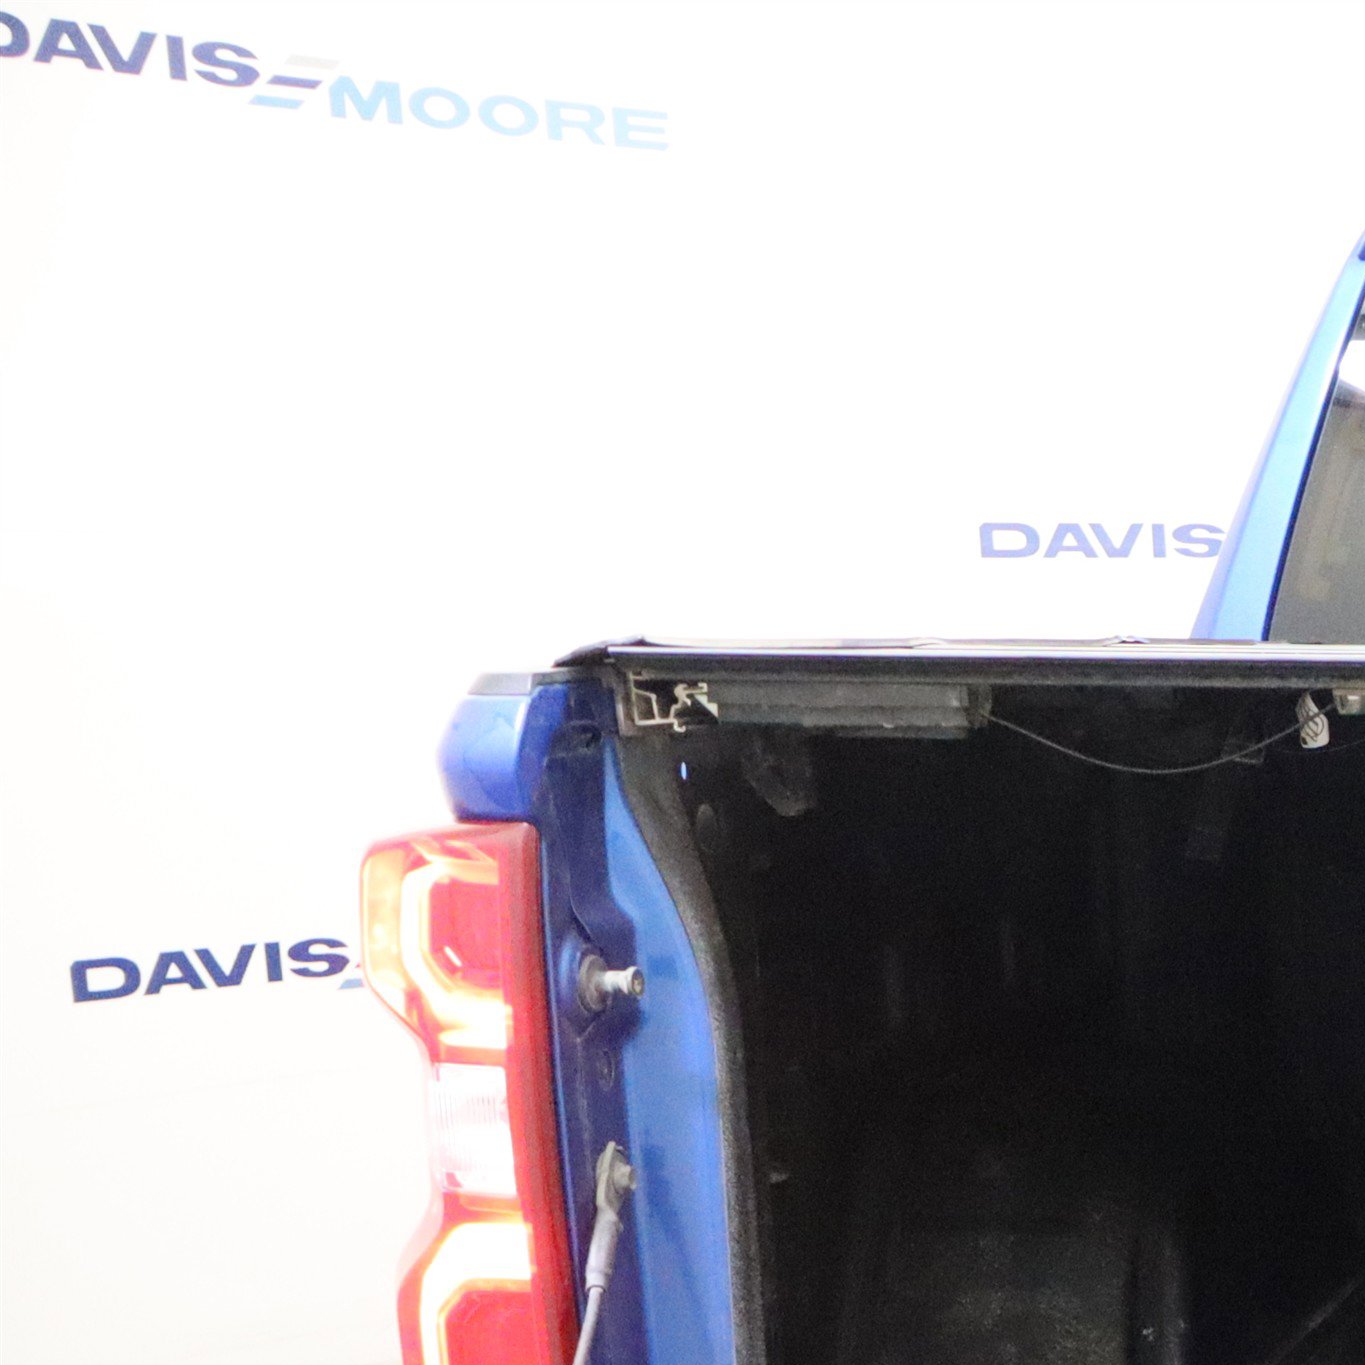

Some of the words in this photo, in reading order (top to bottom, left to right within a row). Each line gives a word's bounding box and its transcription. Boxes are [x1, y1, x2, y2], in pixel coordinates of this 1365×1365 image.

[328, 75, 668, 151] MOORE
[979, 522, 1225, 558] DAVIS
[70, 937, 350, 1003] DAVIS
